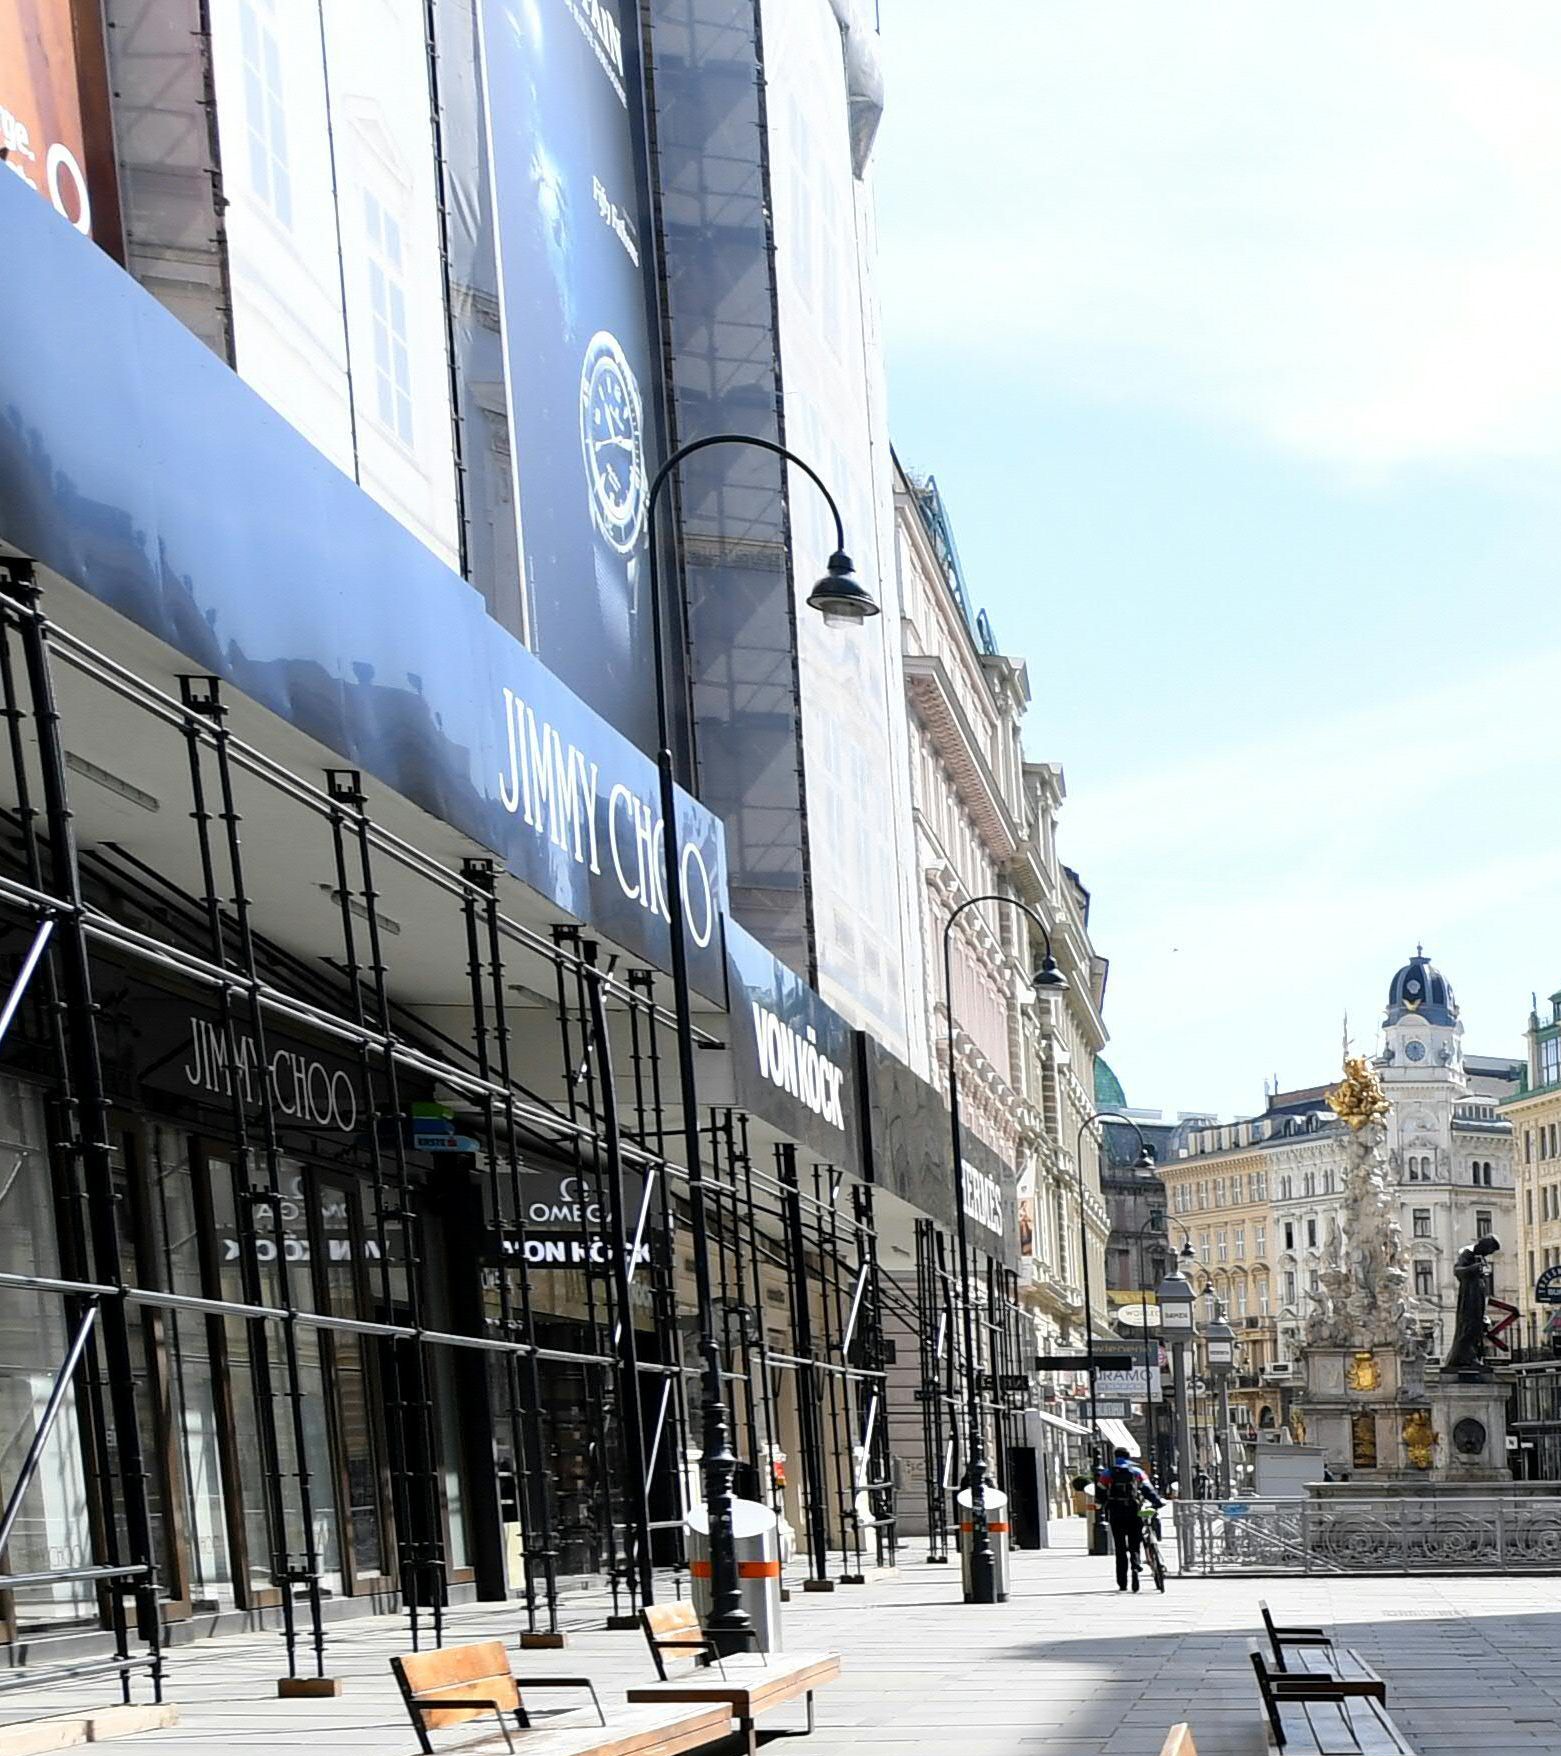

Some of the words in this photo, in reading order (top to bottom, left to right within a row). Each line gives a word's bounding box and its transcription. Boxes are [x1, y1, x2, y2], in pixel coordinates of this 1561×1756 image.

[499, 686, 602, 876] JIMMY
[272, 1049, 356, 1132] CHOO
[752, 1000, 799, 1099] VON
